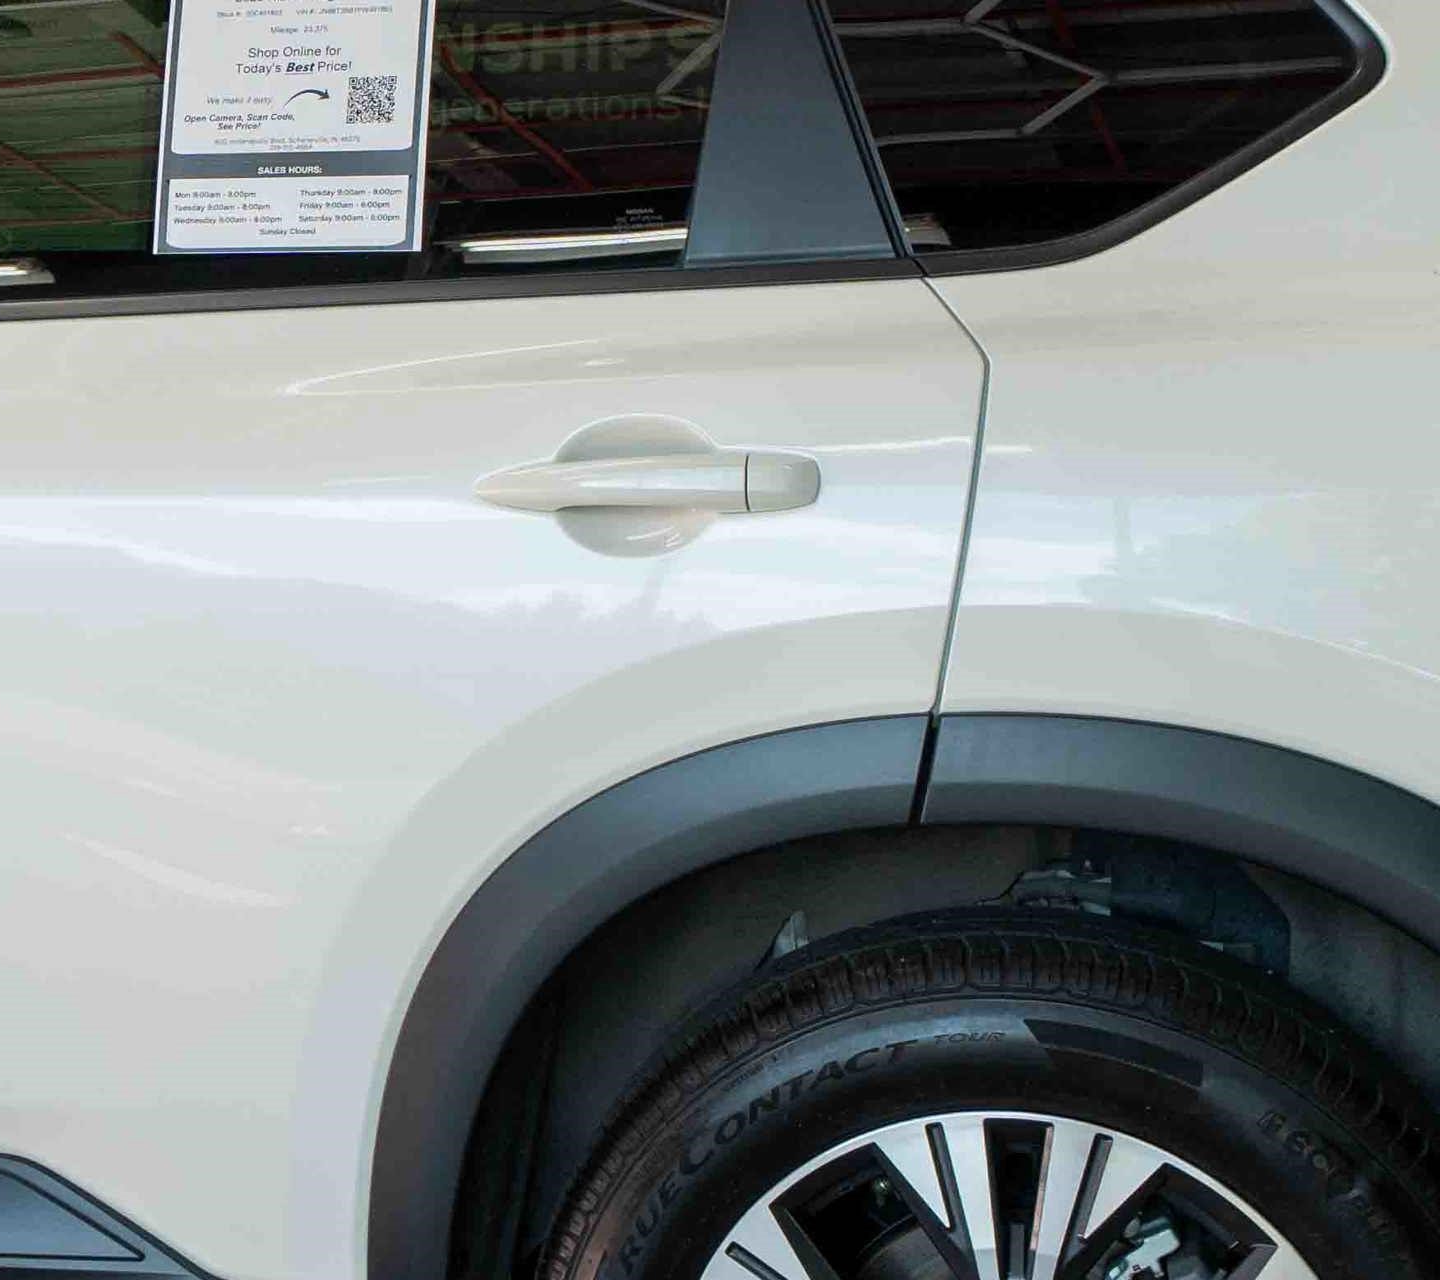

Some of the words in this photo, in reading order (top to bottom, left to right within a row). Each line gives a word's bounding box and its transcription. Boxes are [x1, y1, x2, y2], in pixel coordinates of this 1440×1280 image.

[248, 46, 280, 61] Shop
[283, 45, 323, 58] Online
[324, 45, 342, 57] for
[235, 61, 282, 75] Today's
[285, 60, 316, 73] Best
[317, 60, 353, 72] Price!
[184, 114, 207, 124] Open
[247, 113, 268, 121] Scan
[257, 166, 286, 175] SALES
[287, 165, 323, 174] HOURS:
[300, 189, 336, 198] Thursday
[299, 201, 322, 210] Friday
[298, 214, 332, 224] Saturday
[932, 1029, 1008, 1046] TOUR
